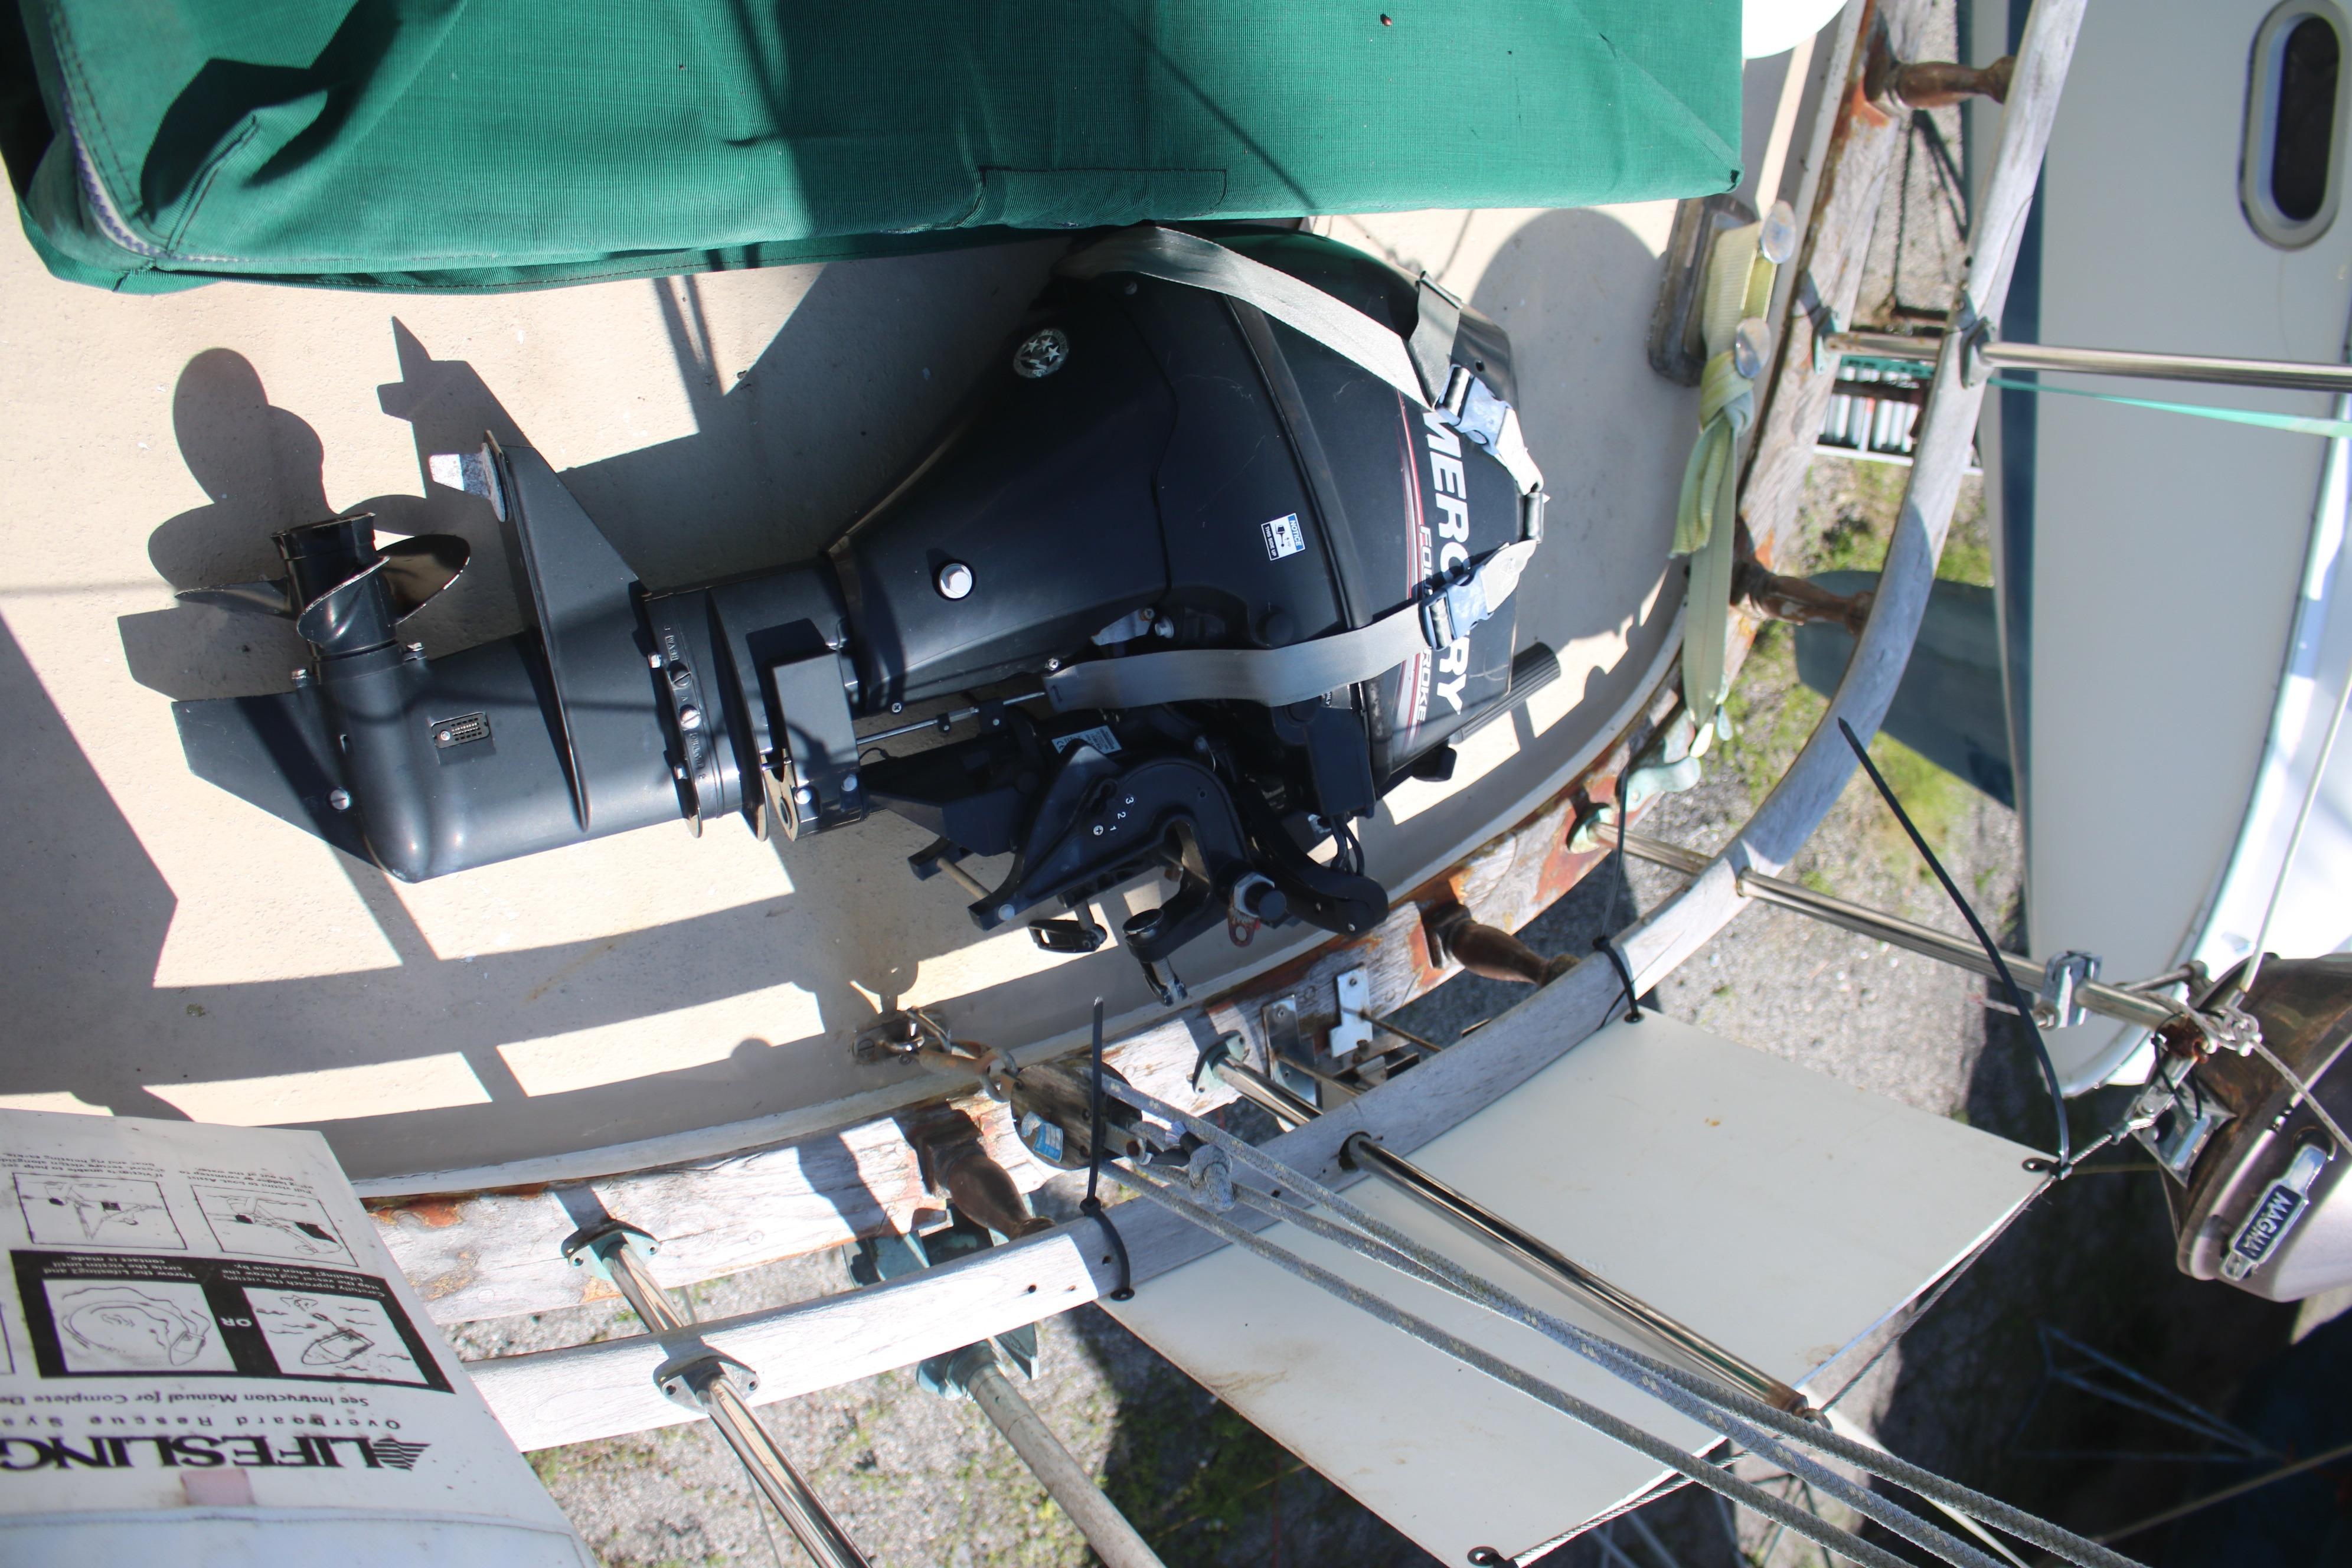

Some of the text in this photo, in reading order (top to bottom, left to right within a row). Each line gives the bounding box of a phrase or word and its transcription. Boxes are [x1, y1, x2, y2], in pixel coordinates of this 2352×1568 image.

[1289, 520, 1302, 547] NOTICE
[1422, 410, 1469, 715] MERCRY
[2240, 1191, 2292, 1260] MAGMA
[233, 1262, 250, 1270] by.
[157, 1270, 196, 1279] Throw
[222, 1274, 262, 1282] victim,
[302, 1275, 334, 1284] vessel
[286, 1279, 336, 1291] approach
[339, 1285, 386, 1297] Carefully
[219, 1315, 253, 1329] OR
[33, 1392, 128, 1404] Complete
[135, 1391, 161, 1404] for
[168, 1393, 237, 1404] Manual
[243, 1393, 335, 1406] Instruction
[340, 1396, 369, 1407] See
[89, 1416, 213, 1427] Rescue
[235, 1415, 401, 1430] Overboard
